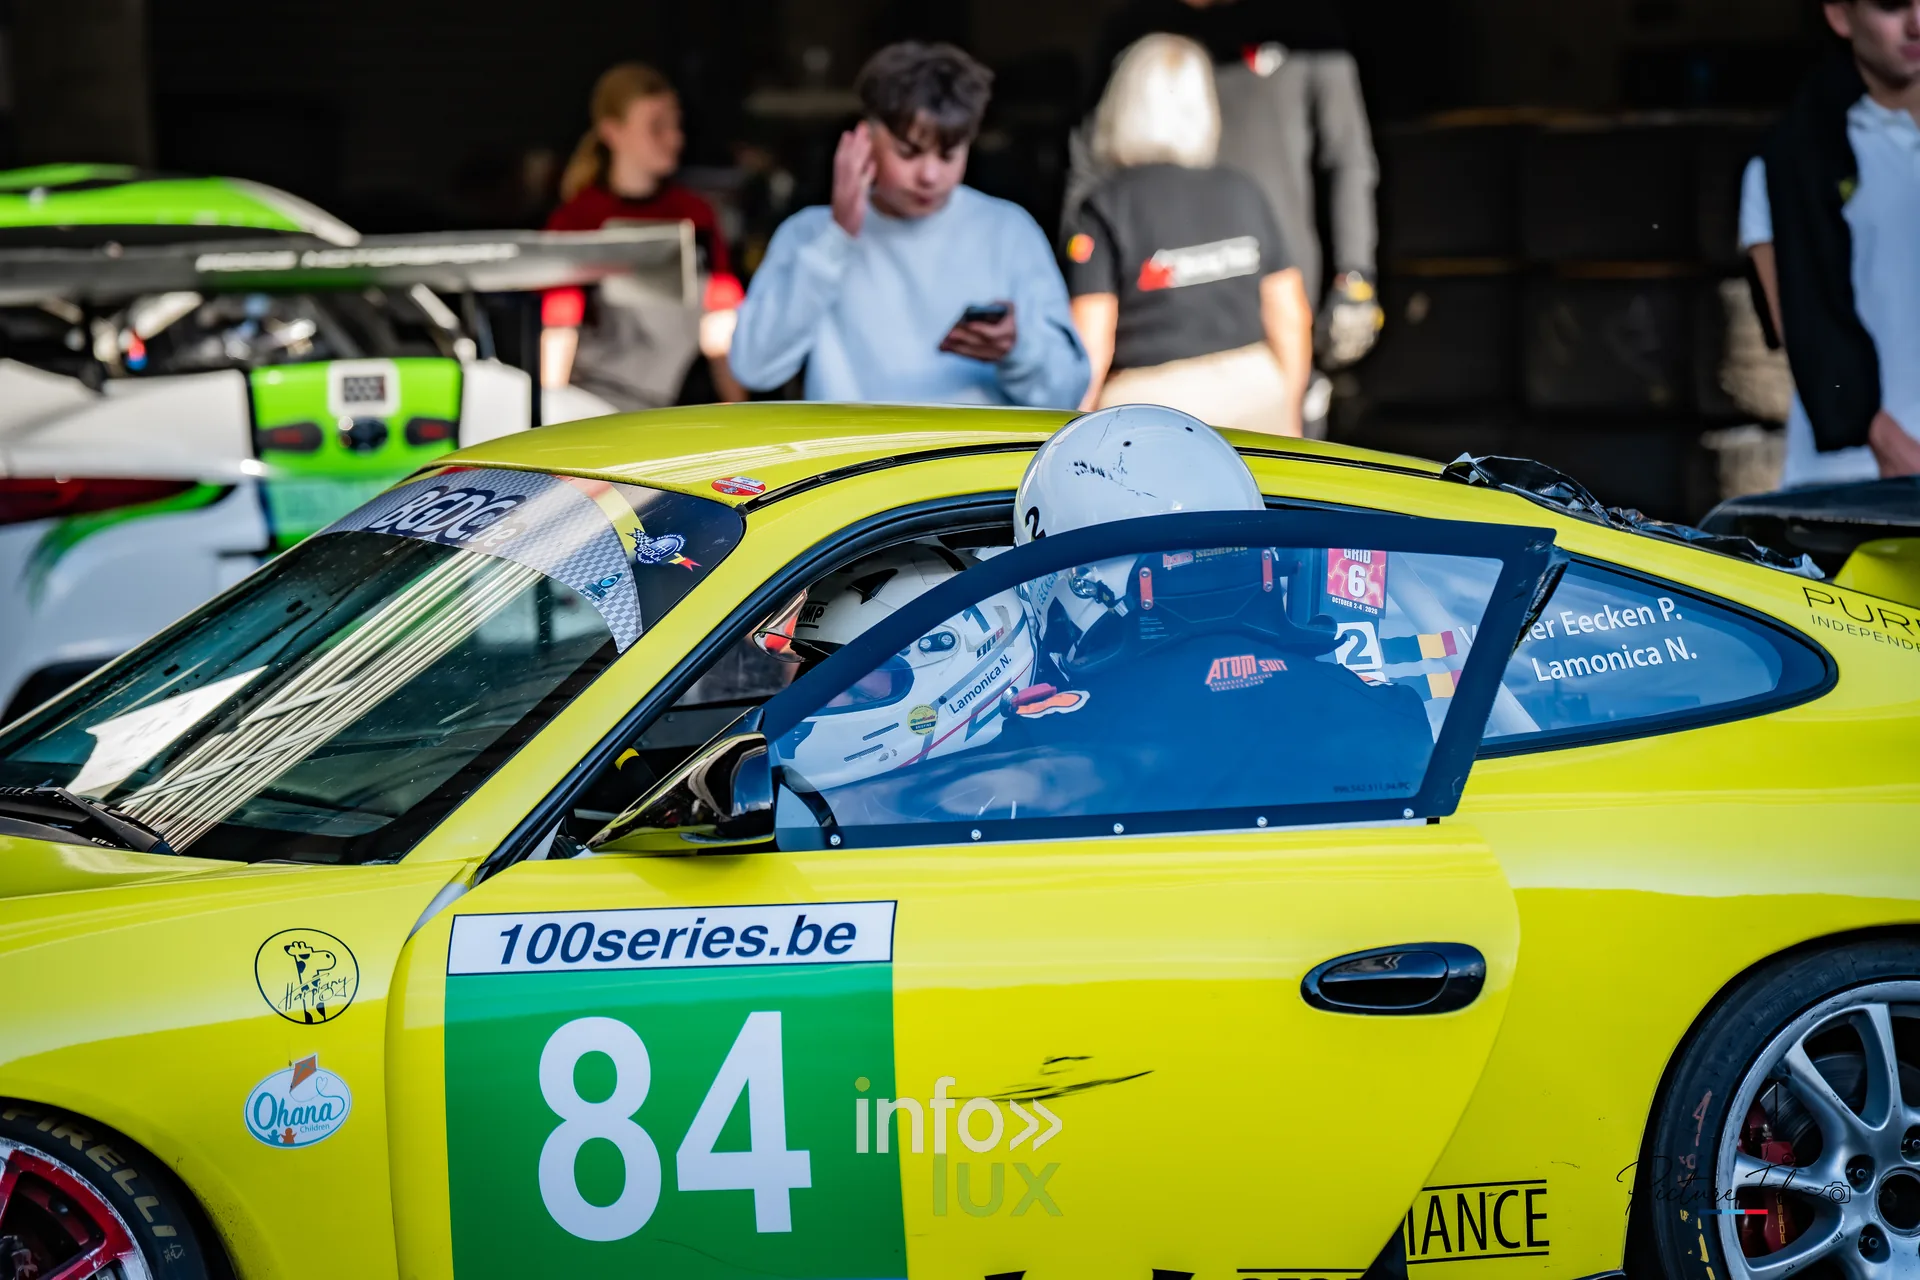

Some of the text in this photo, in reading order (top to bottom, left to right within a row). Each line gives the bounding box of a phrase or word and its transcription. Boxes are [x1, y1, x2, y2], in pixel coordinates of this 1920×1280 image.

[1343, 548, 1372, 564] GRID
[1347, 564, 1367, 598] 6
[1331, 596, 1353, 608] OCTOBER
[1559, 604, 1656, 636] Eecken
[1657, 597, 1683, 622] P.
[1345, 628, 1373, 666] 2
[1531, 636, 1698, 682] Lamonica N.
[949, 654, 1012, 714] Lamonica N.
[1205, 655, 1257, 684] ATOM
[1259, 660, 1288, 672] SUIT
[498, 915, 858, 966] 100series.be
[253, 1091, 346, 1130] Ohana
[300, 1123, 330, 1133] Children
[538, 1010, 813, 1242] 84
[2, 1109, 178, 1237] PIRELLI
